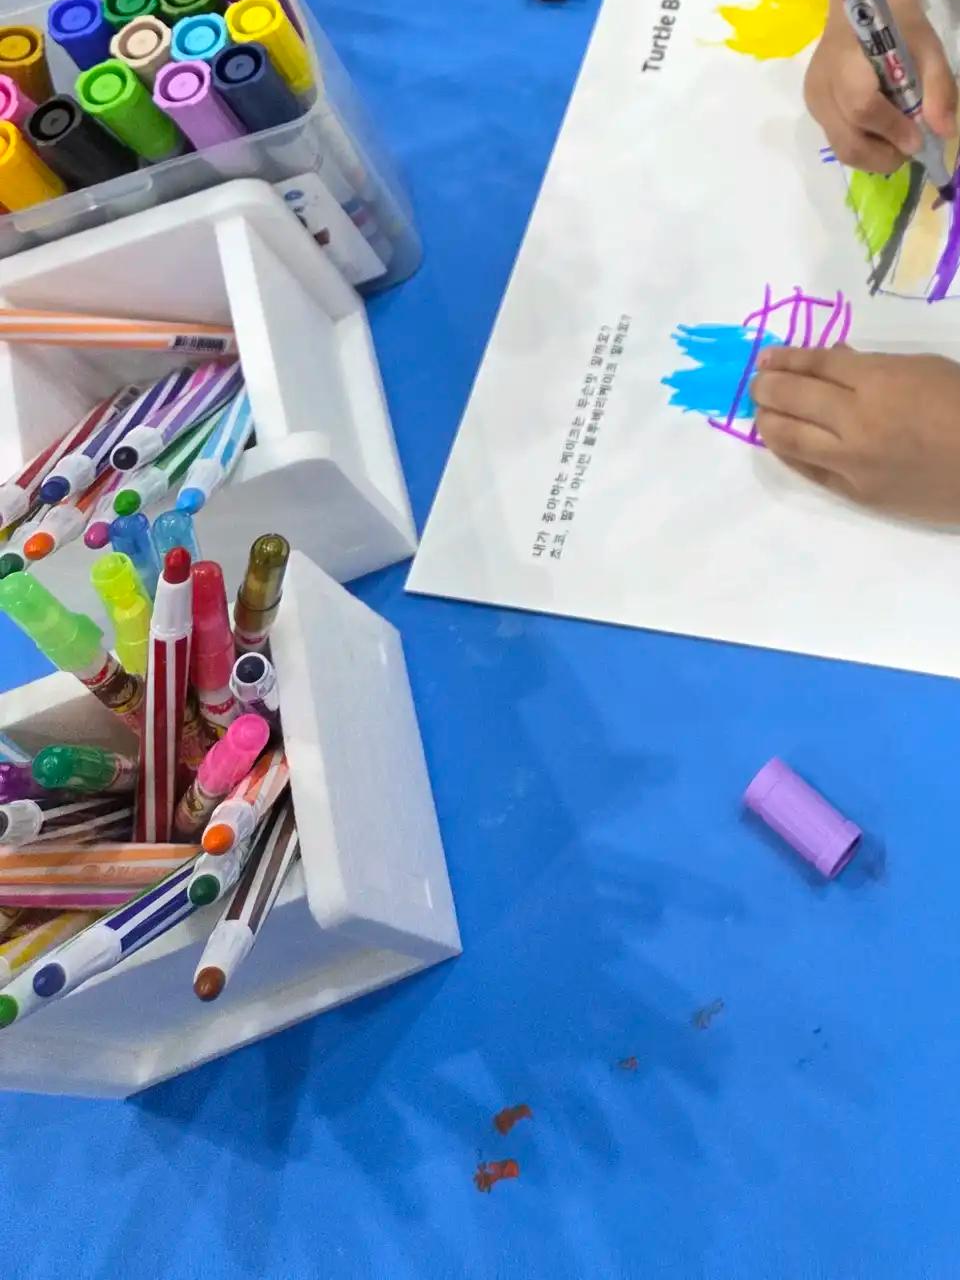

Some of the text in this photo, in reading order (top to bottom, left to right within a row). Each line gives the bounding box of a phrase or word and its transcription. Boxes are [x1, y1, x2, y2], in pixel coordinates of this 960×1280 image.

[640, 14, 677, 73] Turtle
[559, 415, 585, 465] 케이크는
[540, 472, 568, 524] 좋아하는
[559, 496, 579, 521] 딸기
[569, 453, 592, 491] 아니면
[531, 530, 551, 557] 내가
